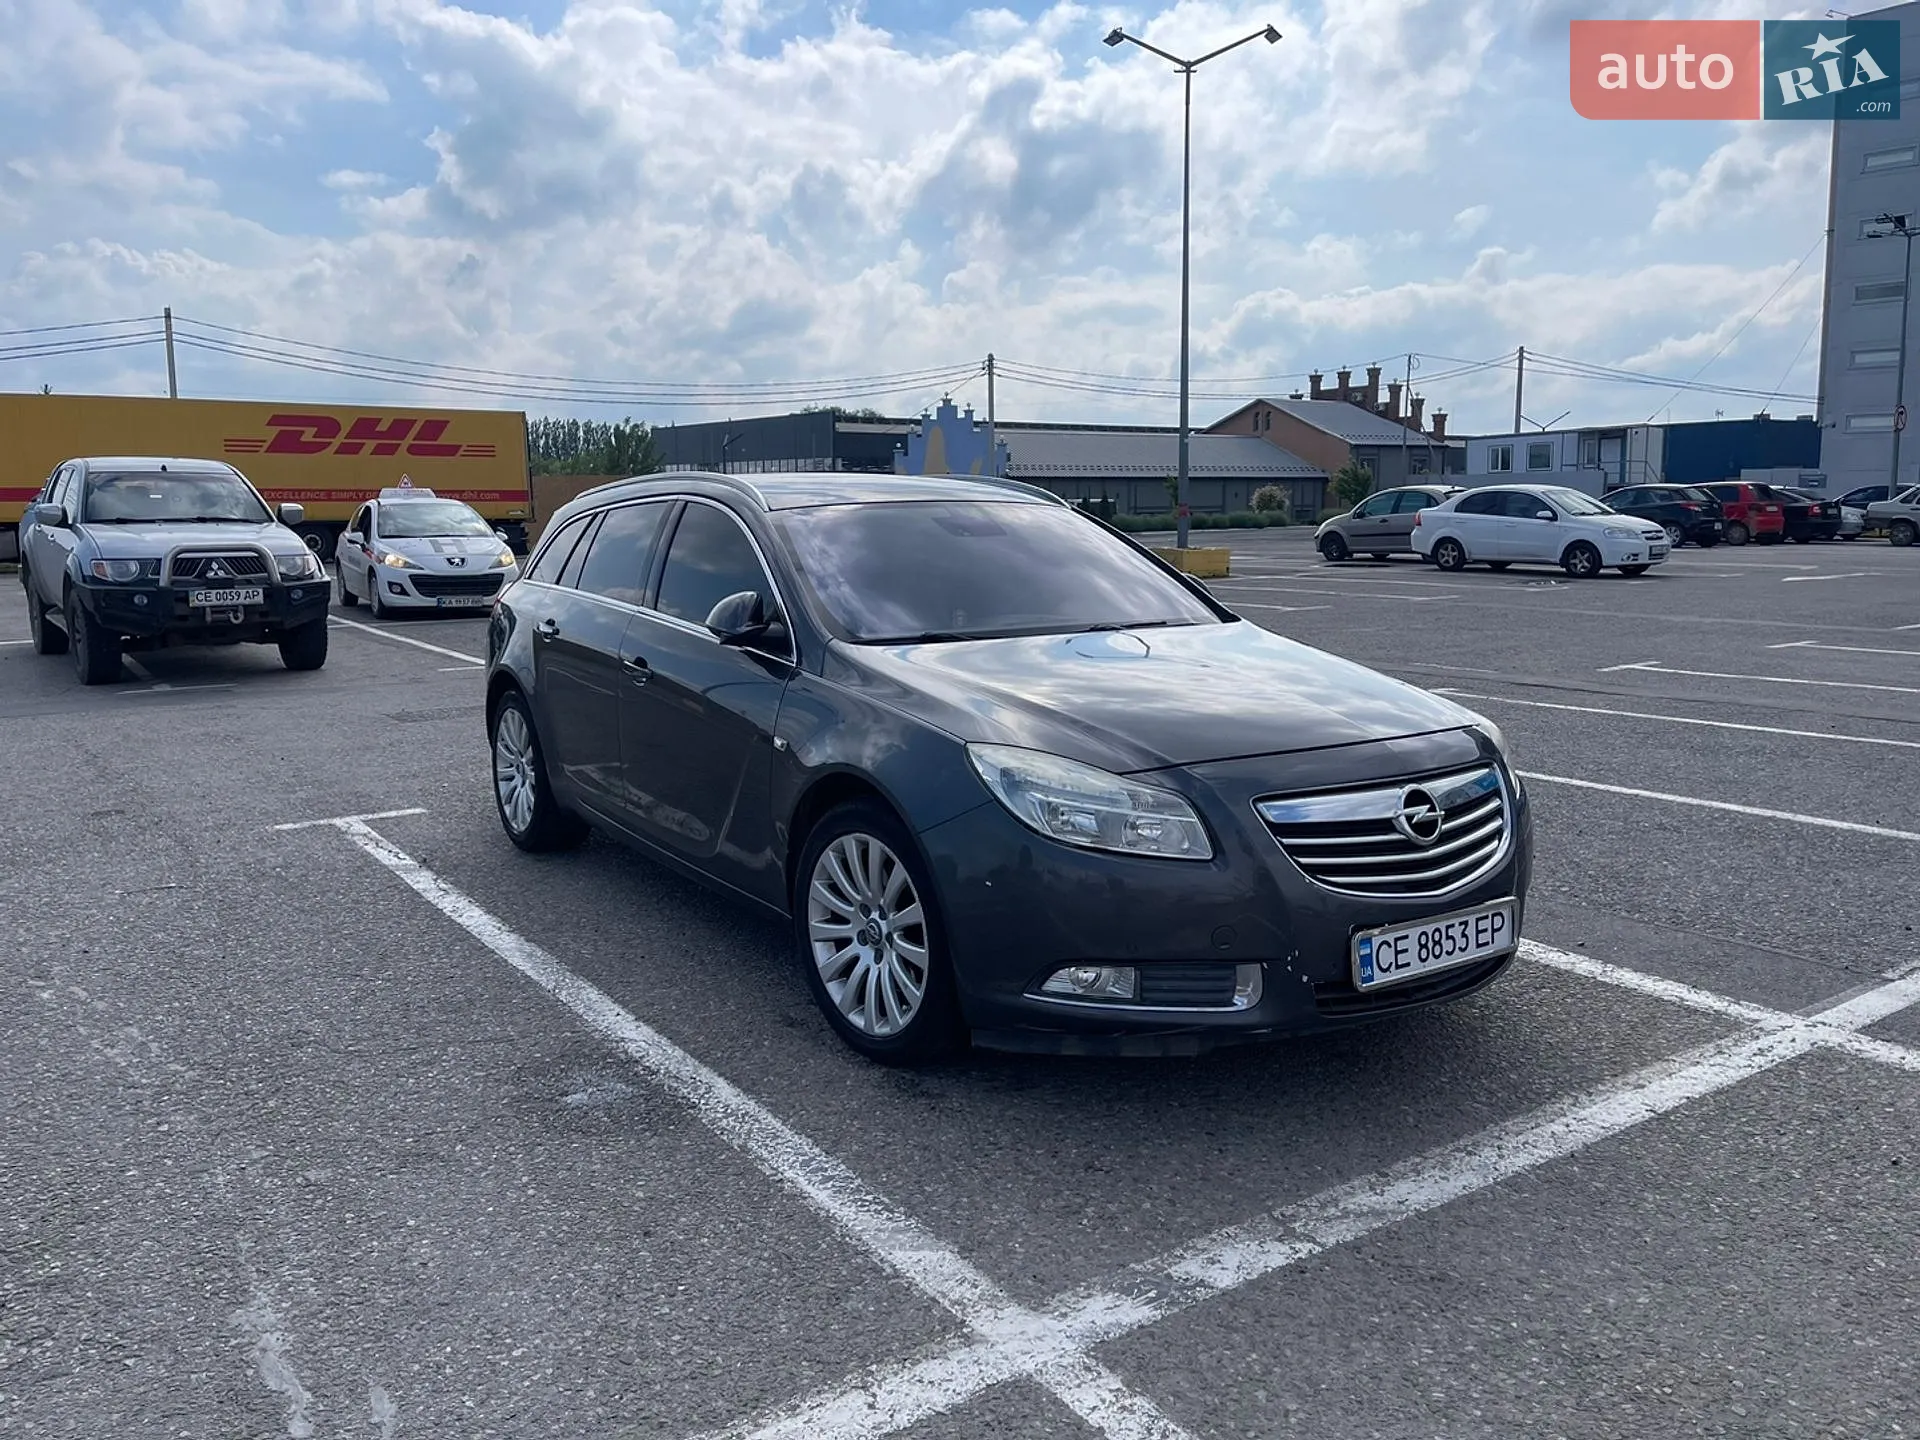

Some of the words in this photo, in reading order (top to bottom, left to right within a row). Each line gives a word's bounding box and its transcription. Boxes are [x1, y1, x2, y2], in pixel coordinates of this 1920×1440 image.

[263, 413, 463, 458] DHL
[331, 490, 364, 500] SIMPLY
[195, 591, 213, 603] CE
[215, 590, 241, 602] 0059
[244, 589, 260, 601] AP
[1375, 934, 1411, 973] CE
[1417, 919, 1470, 963] 8853
[1475, 910, 1506, 949] EP
[1361, 966, 1374, 978] UA
